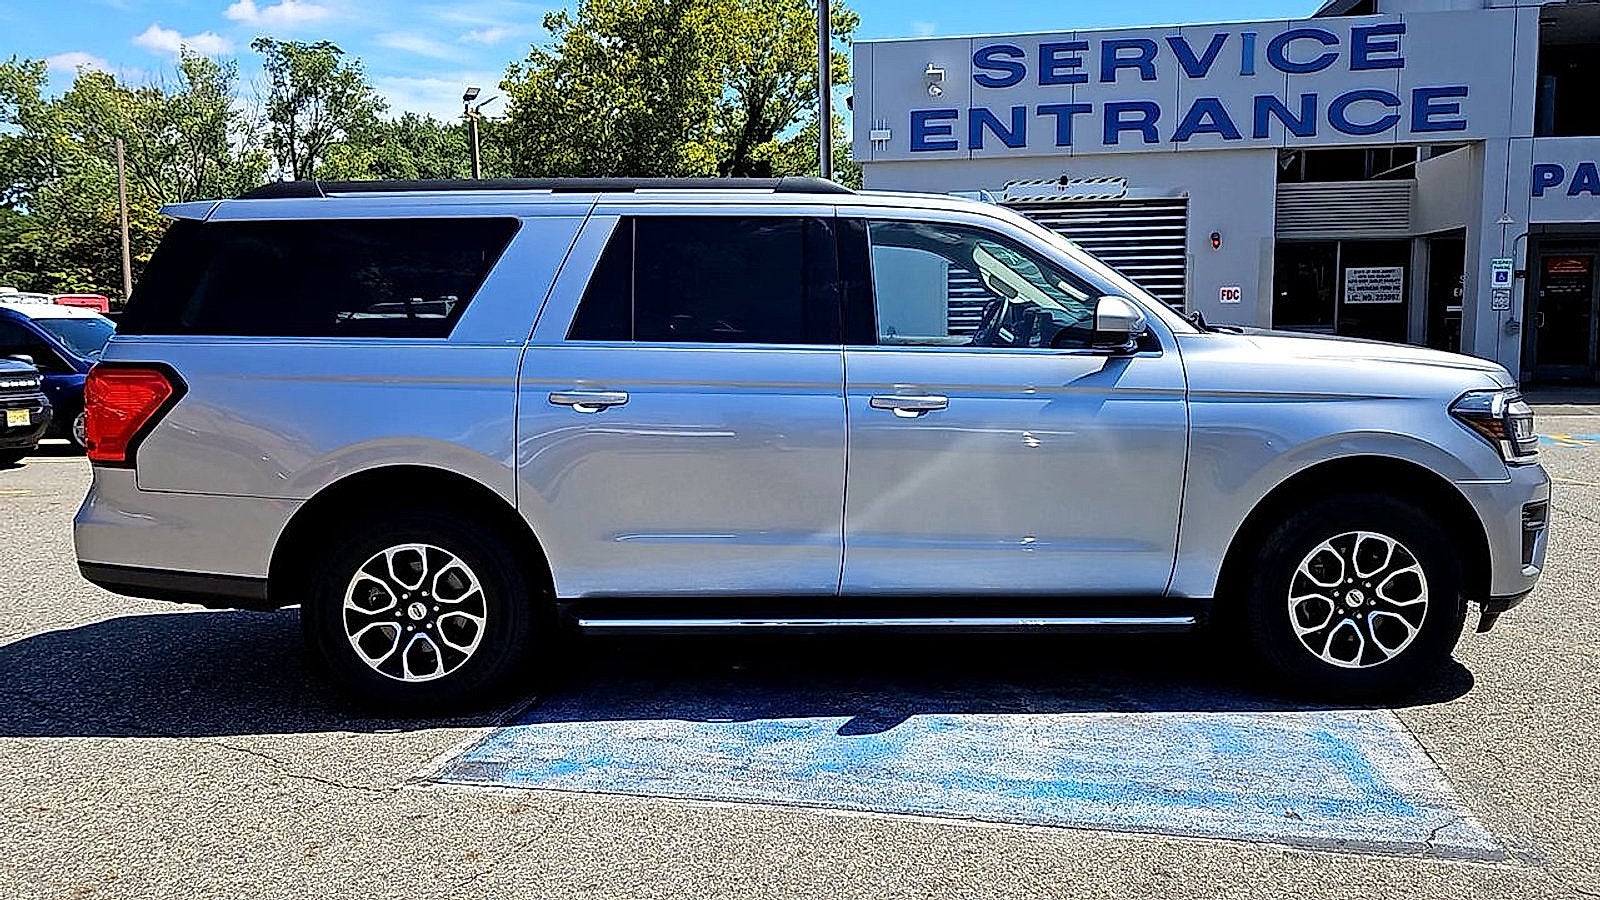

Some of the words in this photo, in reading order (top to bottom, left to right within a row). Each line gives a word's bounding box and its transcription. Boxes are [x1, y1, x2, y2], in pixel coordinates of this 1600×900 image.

[972, 23, 1406, 89] SERVICE
[910, 86, 1468, 152] ENTRANCE
[1531, 162, 1600, 198] PA
[1221, 289, 1240, 301] FDC
